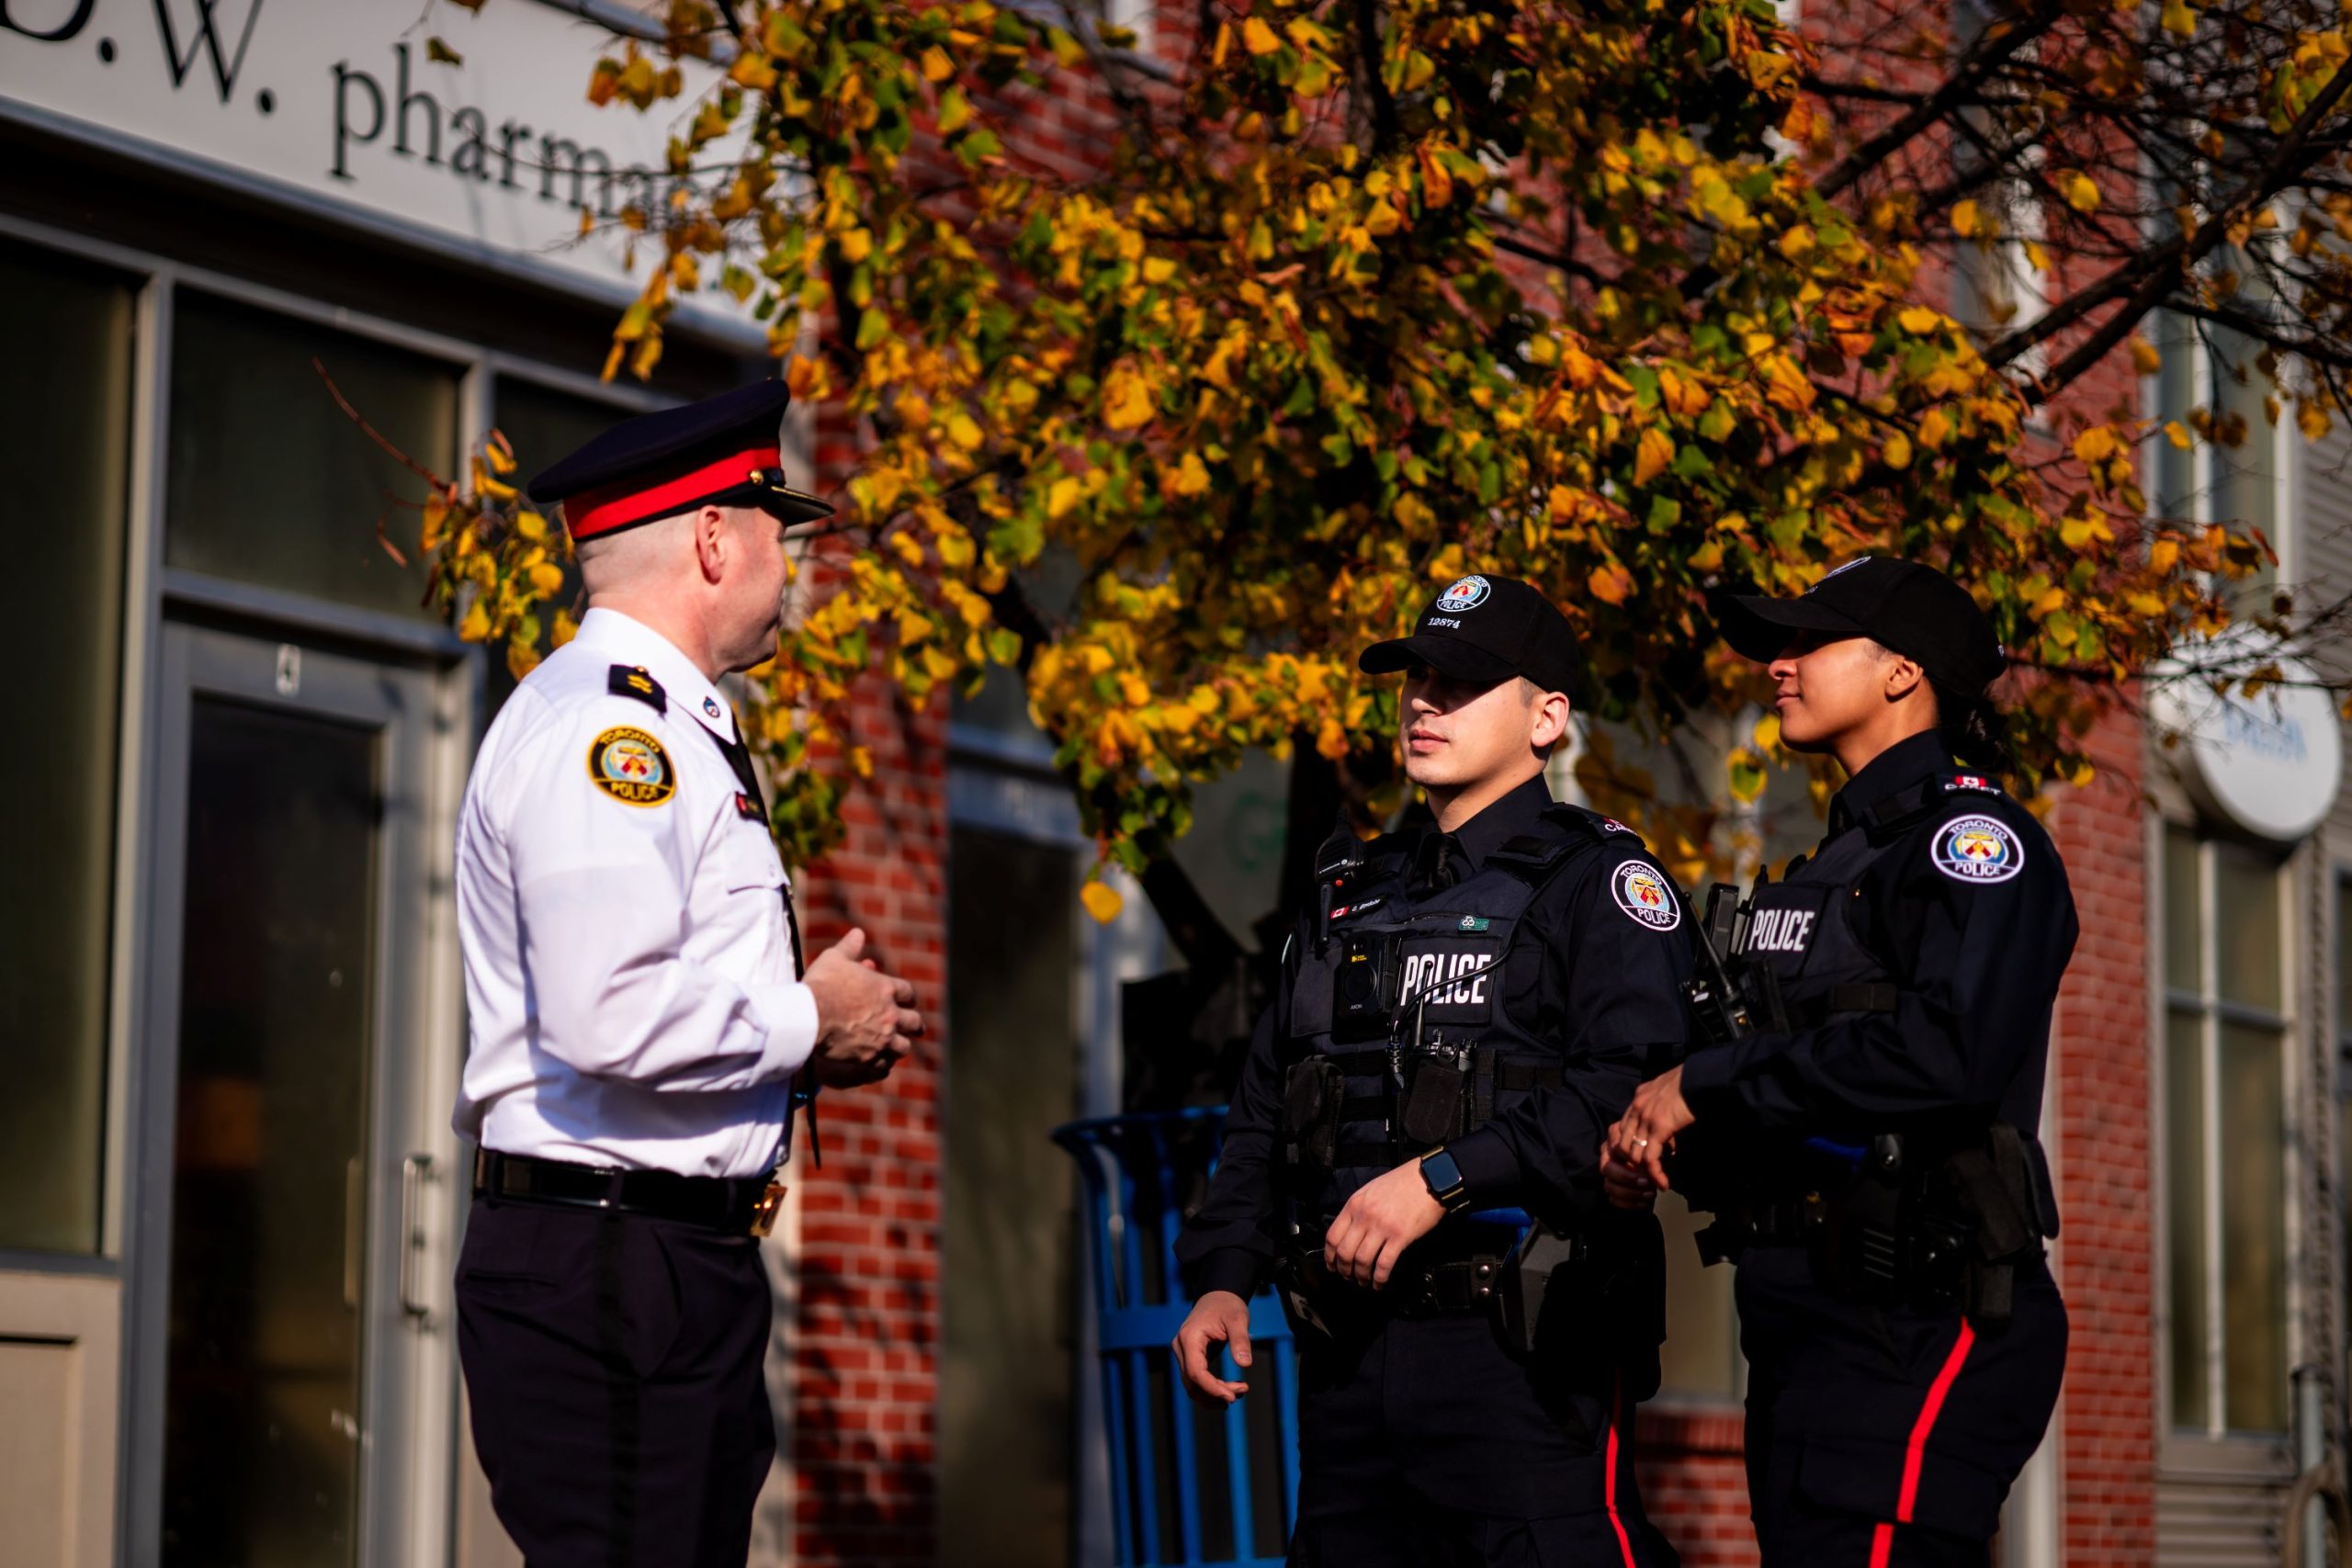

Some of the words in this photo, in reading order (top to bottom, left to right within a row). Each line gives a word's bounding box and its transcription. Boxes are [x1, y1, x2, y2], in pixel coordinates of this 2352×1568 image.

[1428, 617, 1461, 629] 12874
[600, 729, 661, 753] TORONTO
[611, 782, 658, 800] POLICE
[1949, 820, 2008, 840] TORONTO
[1620, 864, 1663, 886] TORONTO
[1955, 862, 2000, 877] POLICE
[1637, 908, 1670, 925] POLICE
[1748, 908, 1815, 952] POLICE
[1400, 953, 1491, 1006] POLICE
